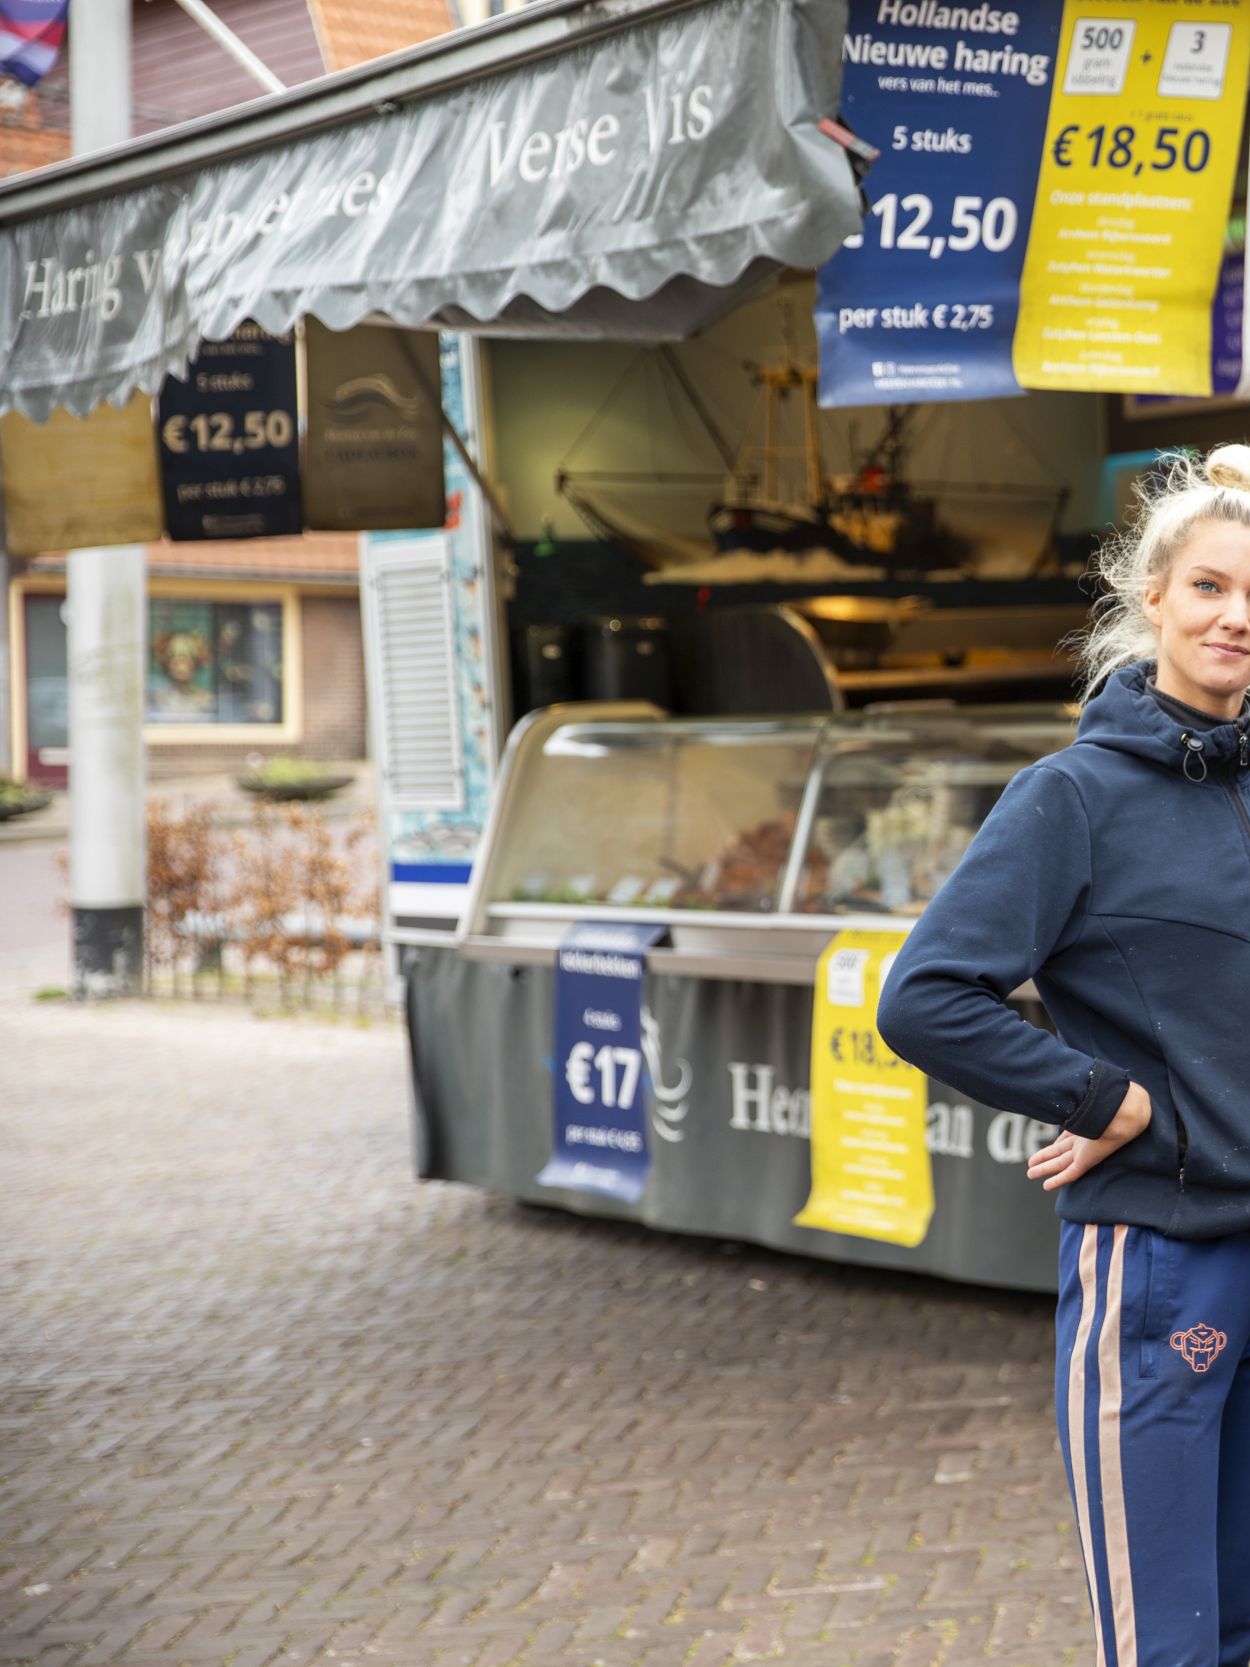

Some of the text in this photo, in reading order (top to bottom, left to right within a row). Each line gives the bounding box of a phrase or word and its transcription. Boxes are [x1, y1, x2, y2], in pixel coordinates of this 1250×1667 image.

[876, 0, 1020, 35] Hollandse
[1081, 27, 1124, 51] 500
[1190, 30, 1206, 54] 3
[842, 34, 1050, 86] Nieuwe haring
[878, 76, 907, 92] vers
[909, 77, 934, 93] van
[936, 77, 961, 95] het
[488, 71, 714, 188] Verse Vis
[891, 126, 972, 153] 5 stuks
[843, 193, 1018, 259] 12,50
[839, 308, 878, 335] per
[881, 303, 930, 329] stuk
[926, 1101, 974, 1159] an
